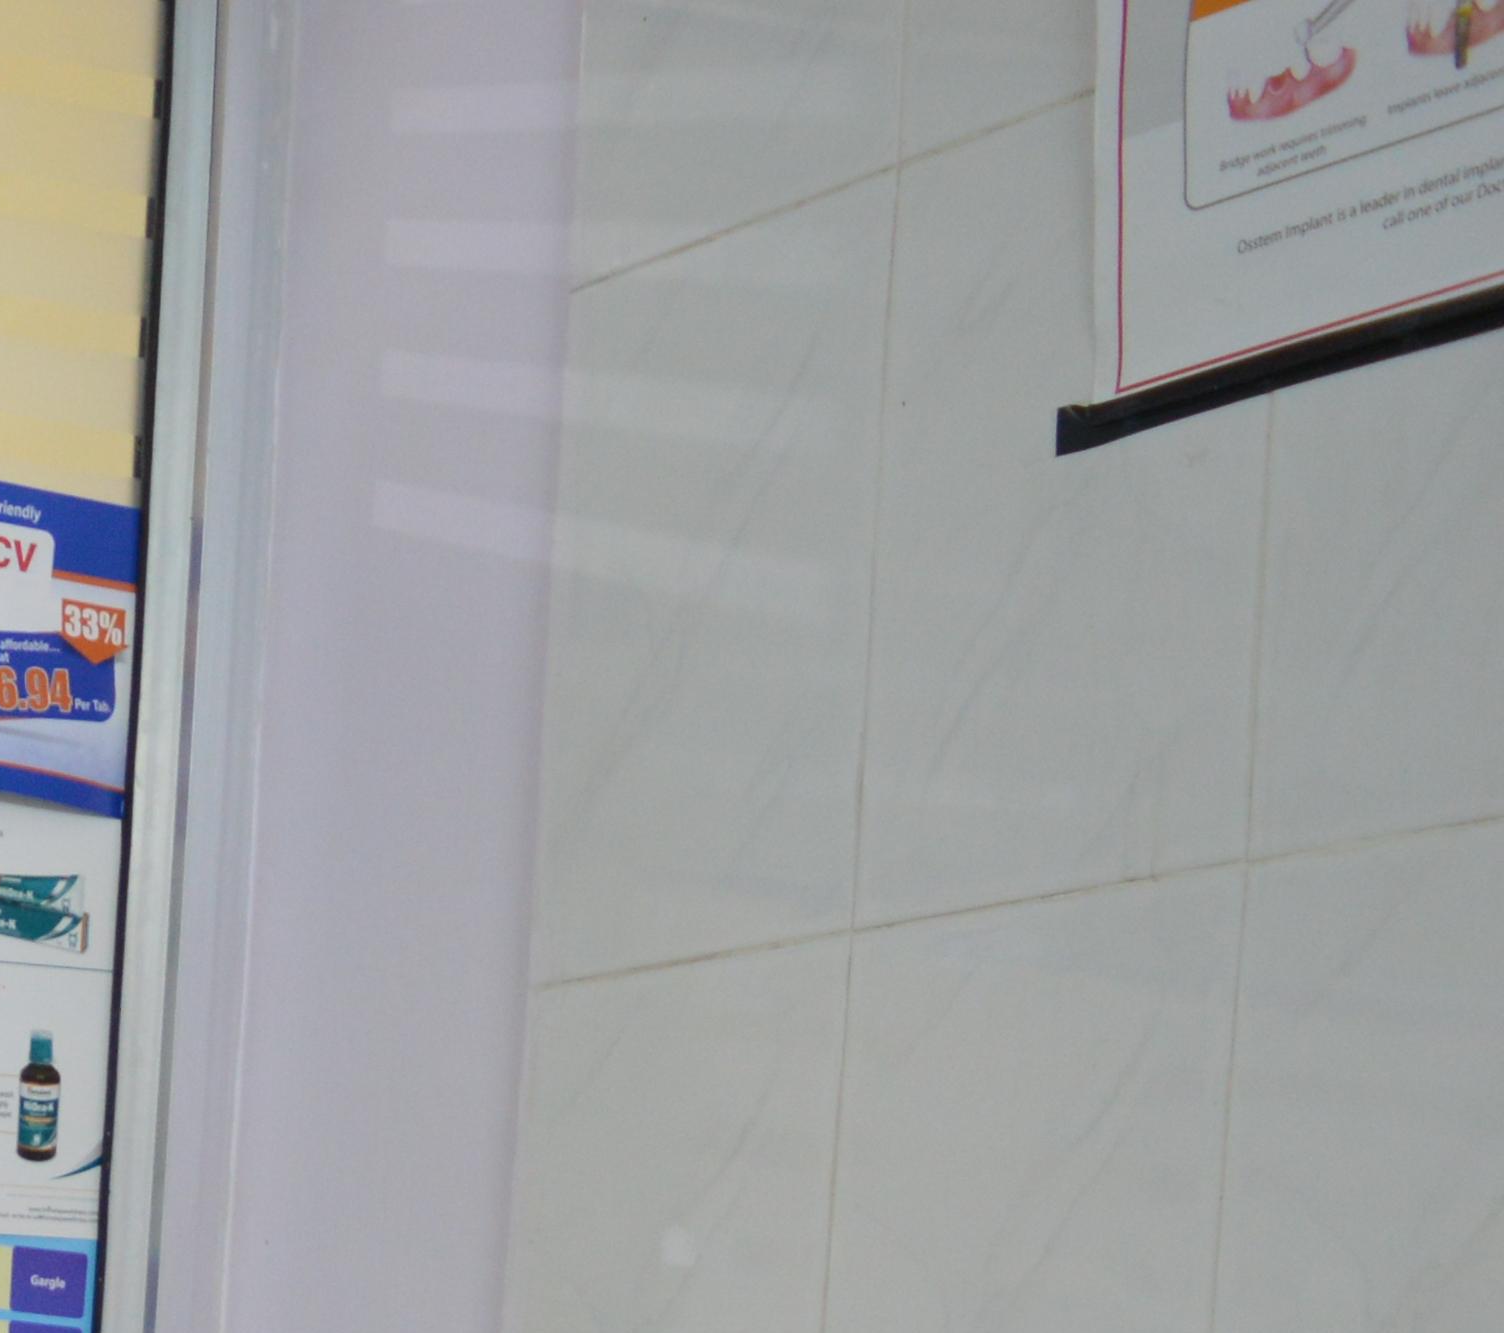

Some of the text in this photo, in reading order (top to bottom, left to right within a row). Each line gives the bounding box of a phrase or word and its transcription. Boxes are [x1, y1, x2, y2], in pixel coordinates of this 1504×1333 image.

[1237, 168, 1461, 254] Osstem Implant is a leader in dental
[1382, 210, 1405, 231] call
[1407, 203, 1432, 222] one
[64, 604, 122, 646] 33%
[0, 653, 10, 663] at
[75, 699, 90, 711] Per
[30, 1274, 66, 1290] Gargle
